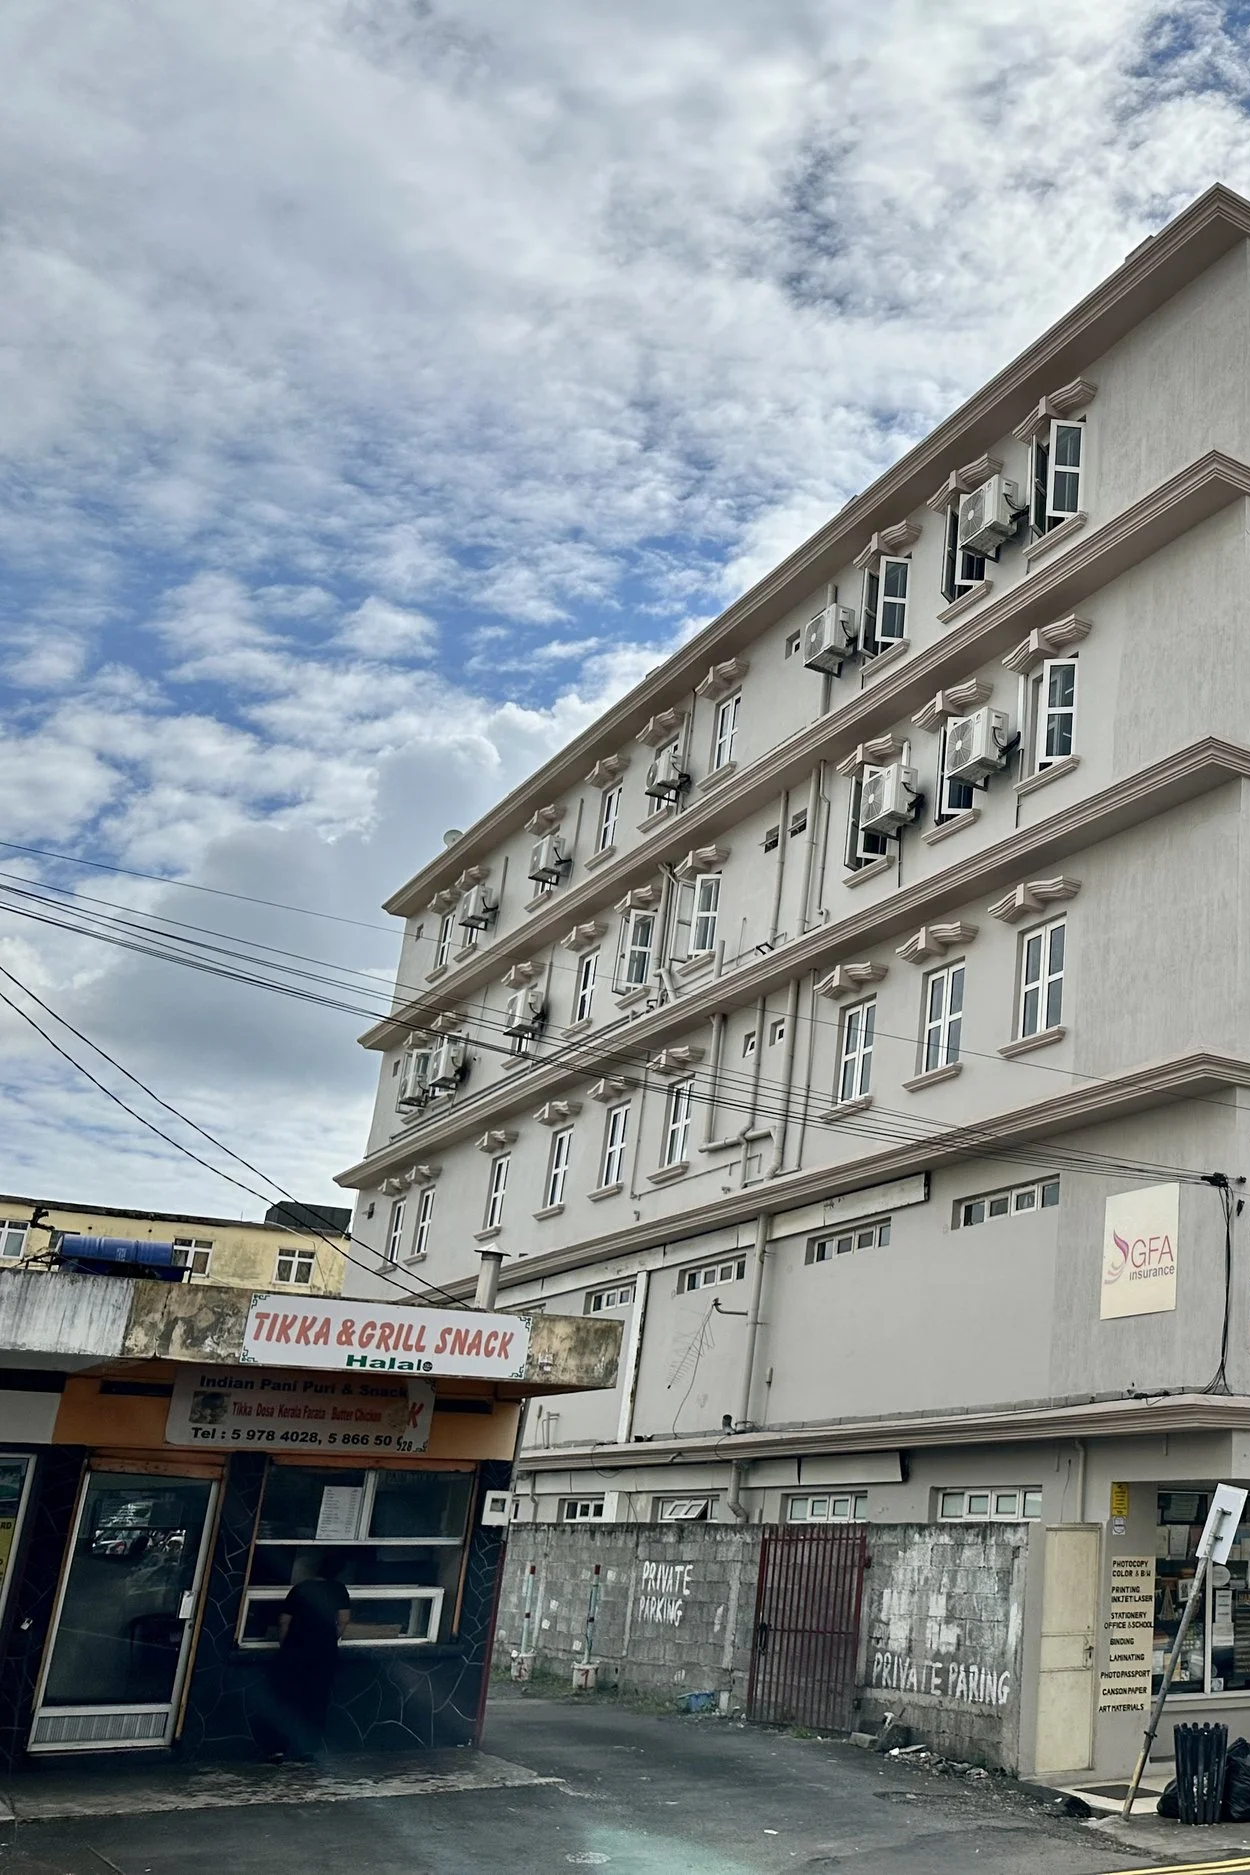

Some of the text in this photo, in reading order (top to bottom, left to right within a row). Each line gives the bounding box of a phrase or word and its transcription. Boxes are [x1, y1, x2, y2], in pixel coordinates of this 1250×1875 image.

[1131, 1235, 1174, 1268] GFA
[1130, 1265, 1175, 1280] insurance
[253, 1312, 331, 1346] TIKKA
[434, 1327, 514, 1359] SNACK
[346, 1354, 422, 1372] Halal
[200, 1375, 254, 1390] Indian
[260, 1379, 297, 1392] Pani
[303, 1380, 336, 1395] Puri
[341, 1383, 353, 1395] &
[232, 1402, 252, 1417] Tikka
[256, 1402, 274, 1417] Dosa
[191, 1427, 216, 1440] Tel
[231, 1429, 242, 1440] 5
[246, 1429, 275, 1442] 978
[328, 1433, 338, 1444] 5
[342, 1434, 369, 1446] 866
[642, 1561, 694, 1596] PRIVATE
[638, 1595, 683, 1627] PARKING
[1110, 1654, 1144, 1662] LAMINATING
[872, 1651, 943, 1696] PRIVATE
